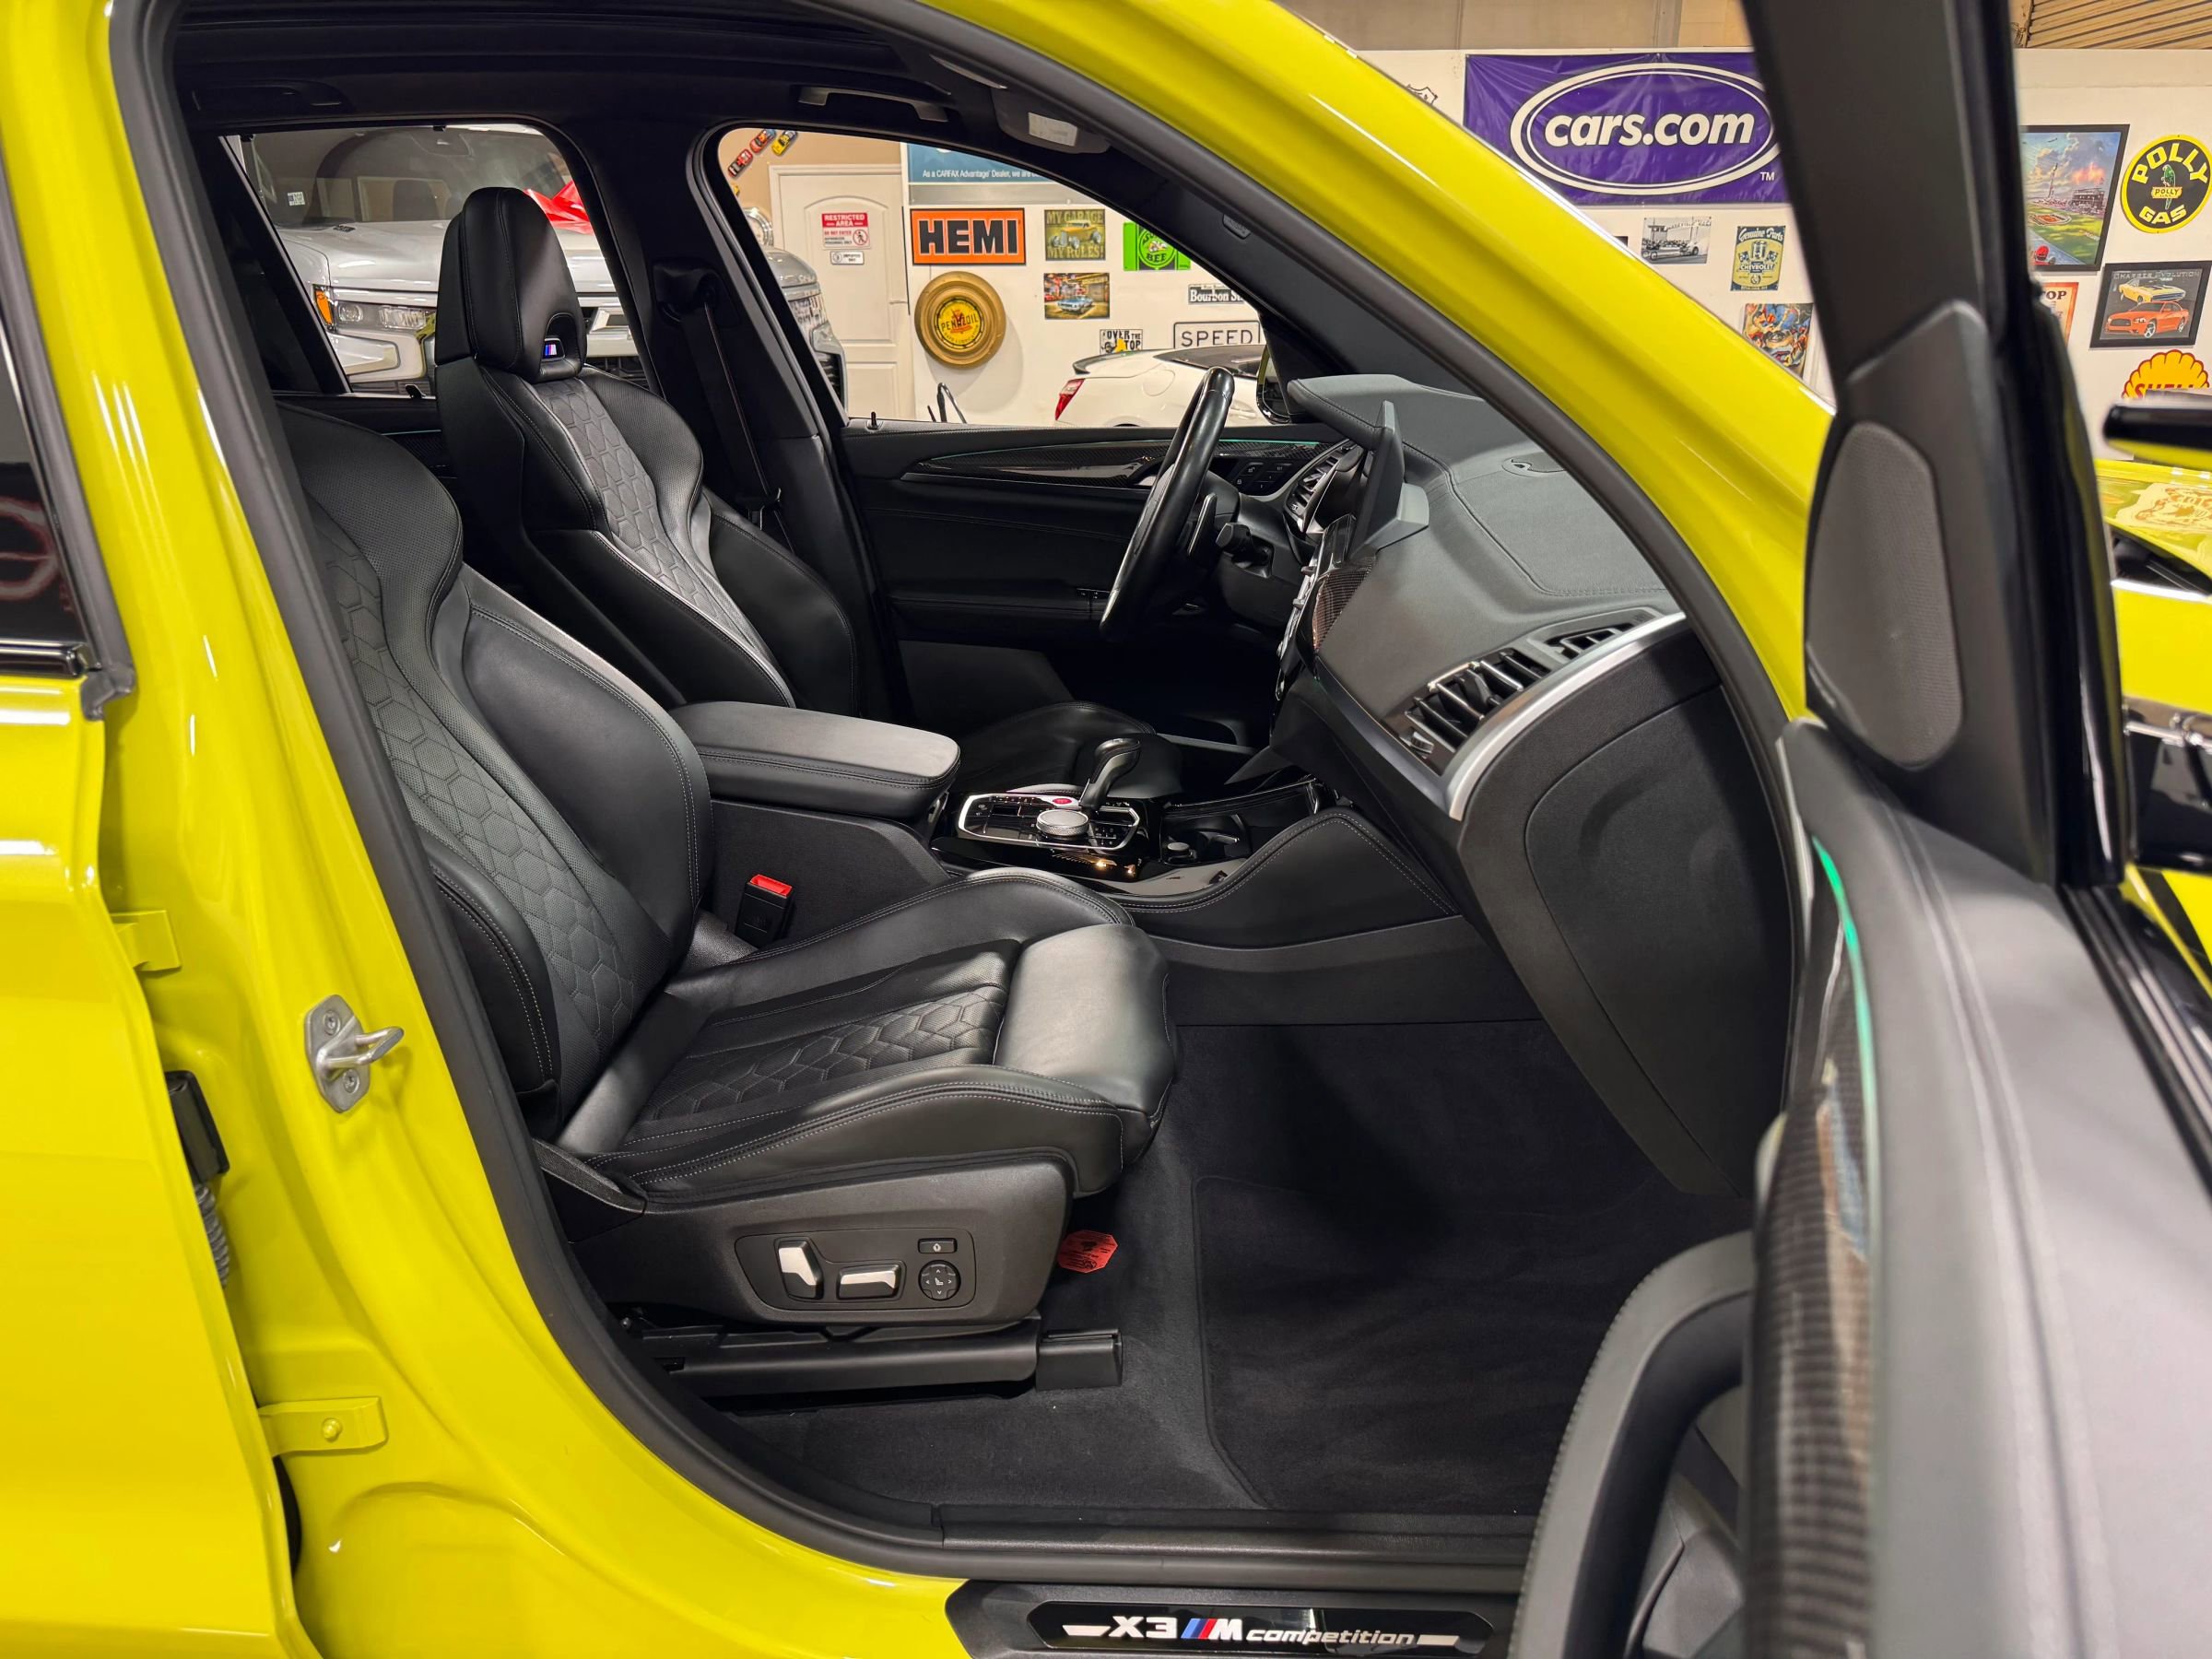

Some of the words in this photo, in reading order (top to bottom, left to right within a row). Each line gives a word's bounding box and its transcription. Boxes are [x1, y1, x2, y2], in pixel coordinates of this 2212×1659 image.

[1545, 112, 1755, 147] cars.com
[1759, 171, 1775, 182] TM
[2132, 143, 2208, 184] POLLY
[923, 170, 931, 178] As
[1046, 210, 1064, 224] MY
[1065, 209, 1104, 223] GARAGE
[2138, 205, 2187, 225] GAS
[918, 219, 1018, 254] HEMI
[1738, 228, 1766, 242] Genuine
[1766, 227, 1784, 241] Parts
[1048, 246, 1065, 259] MY
[1069, 245, 1104, 259] RULES!
[1146, 253, 1168, 263] BEE
[1189, 288, 1230, 302] Bourbon
[1124, 339, 1141, 350] TOP
[1181, 329, 1253, 347] SPEED
[1109, 1616, 1177, 1639] X3
[1246, 1628, 1415, 1646] competition
